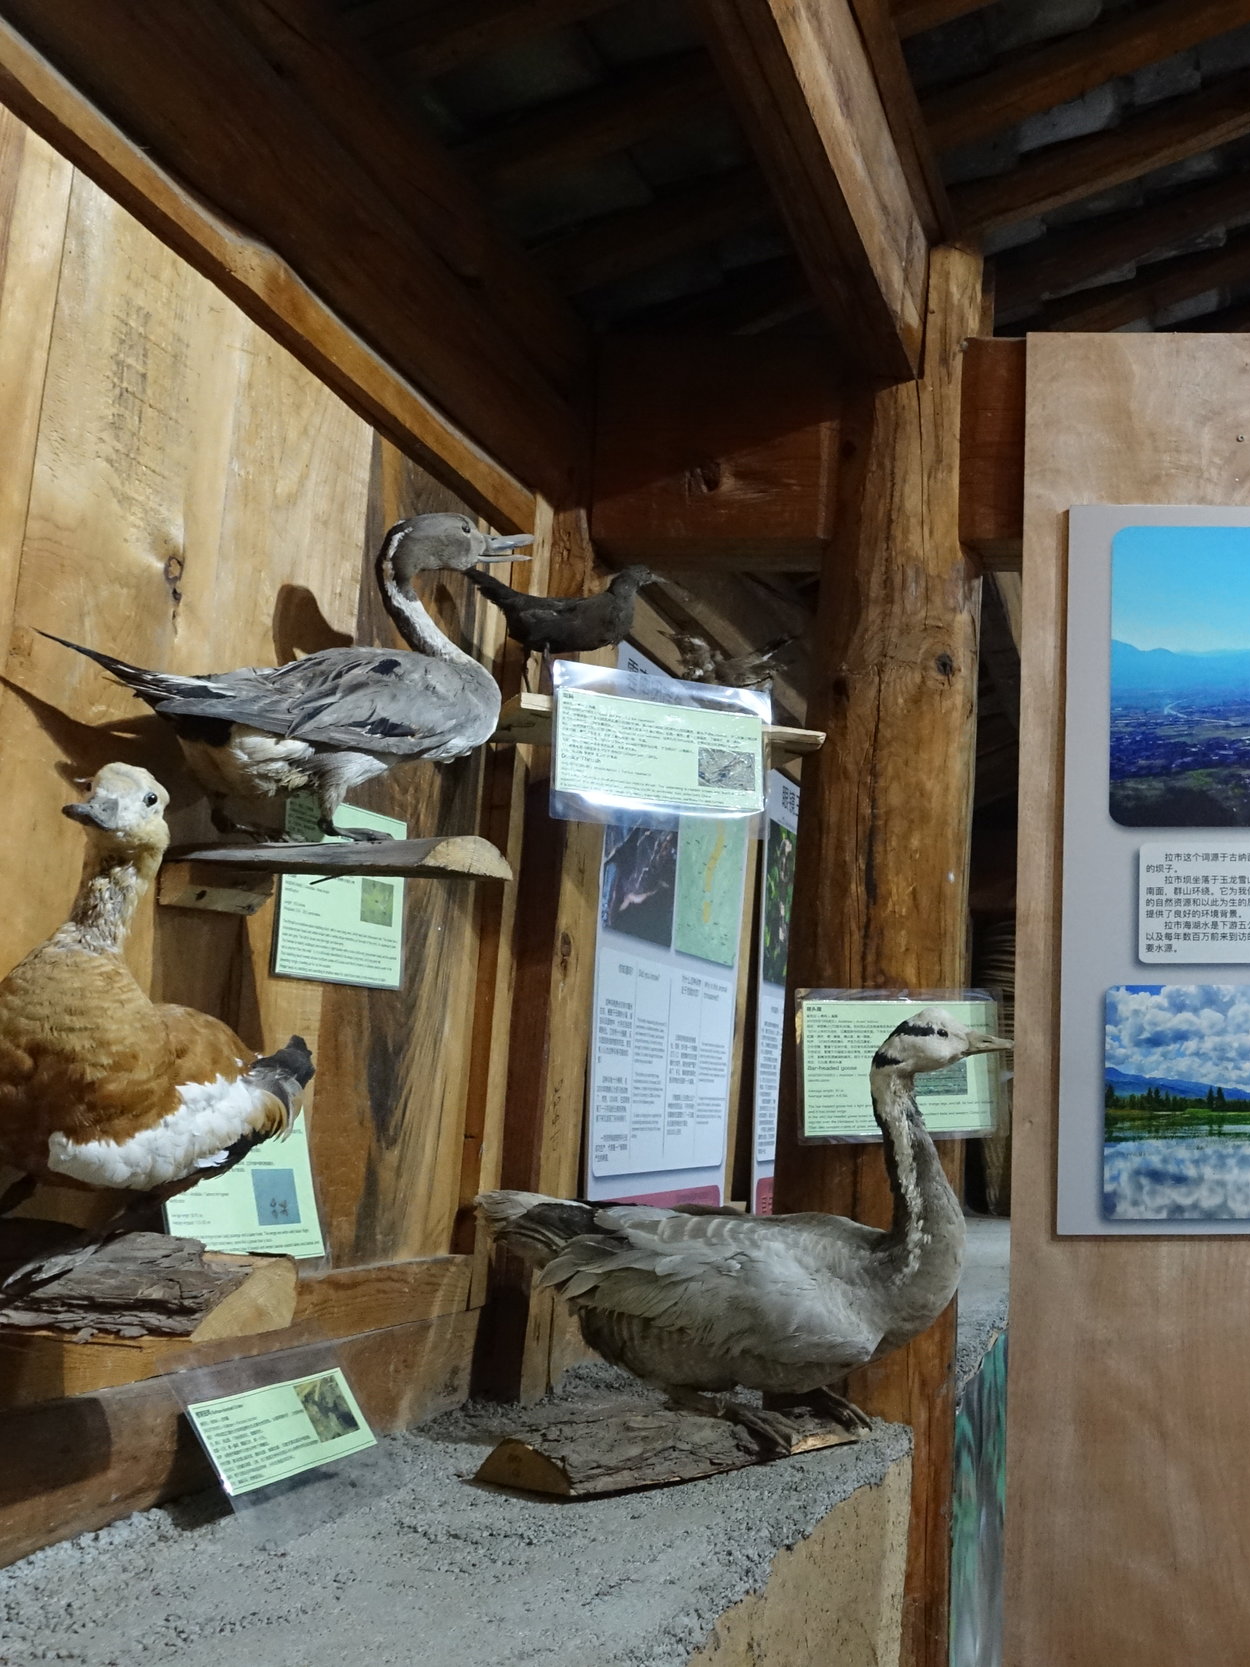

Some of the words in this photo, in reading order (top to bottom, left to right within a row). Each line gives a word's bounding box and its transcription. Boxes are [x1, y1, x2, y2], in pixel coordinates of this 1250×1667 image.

[1145, 864, 1178, 873] 的坝子。
[1145, 909, 1242, 919] 提供了良好的环境背景。
[1145, 944, 1178, 953] 要水源。
